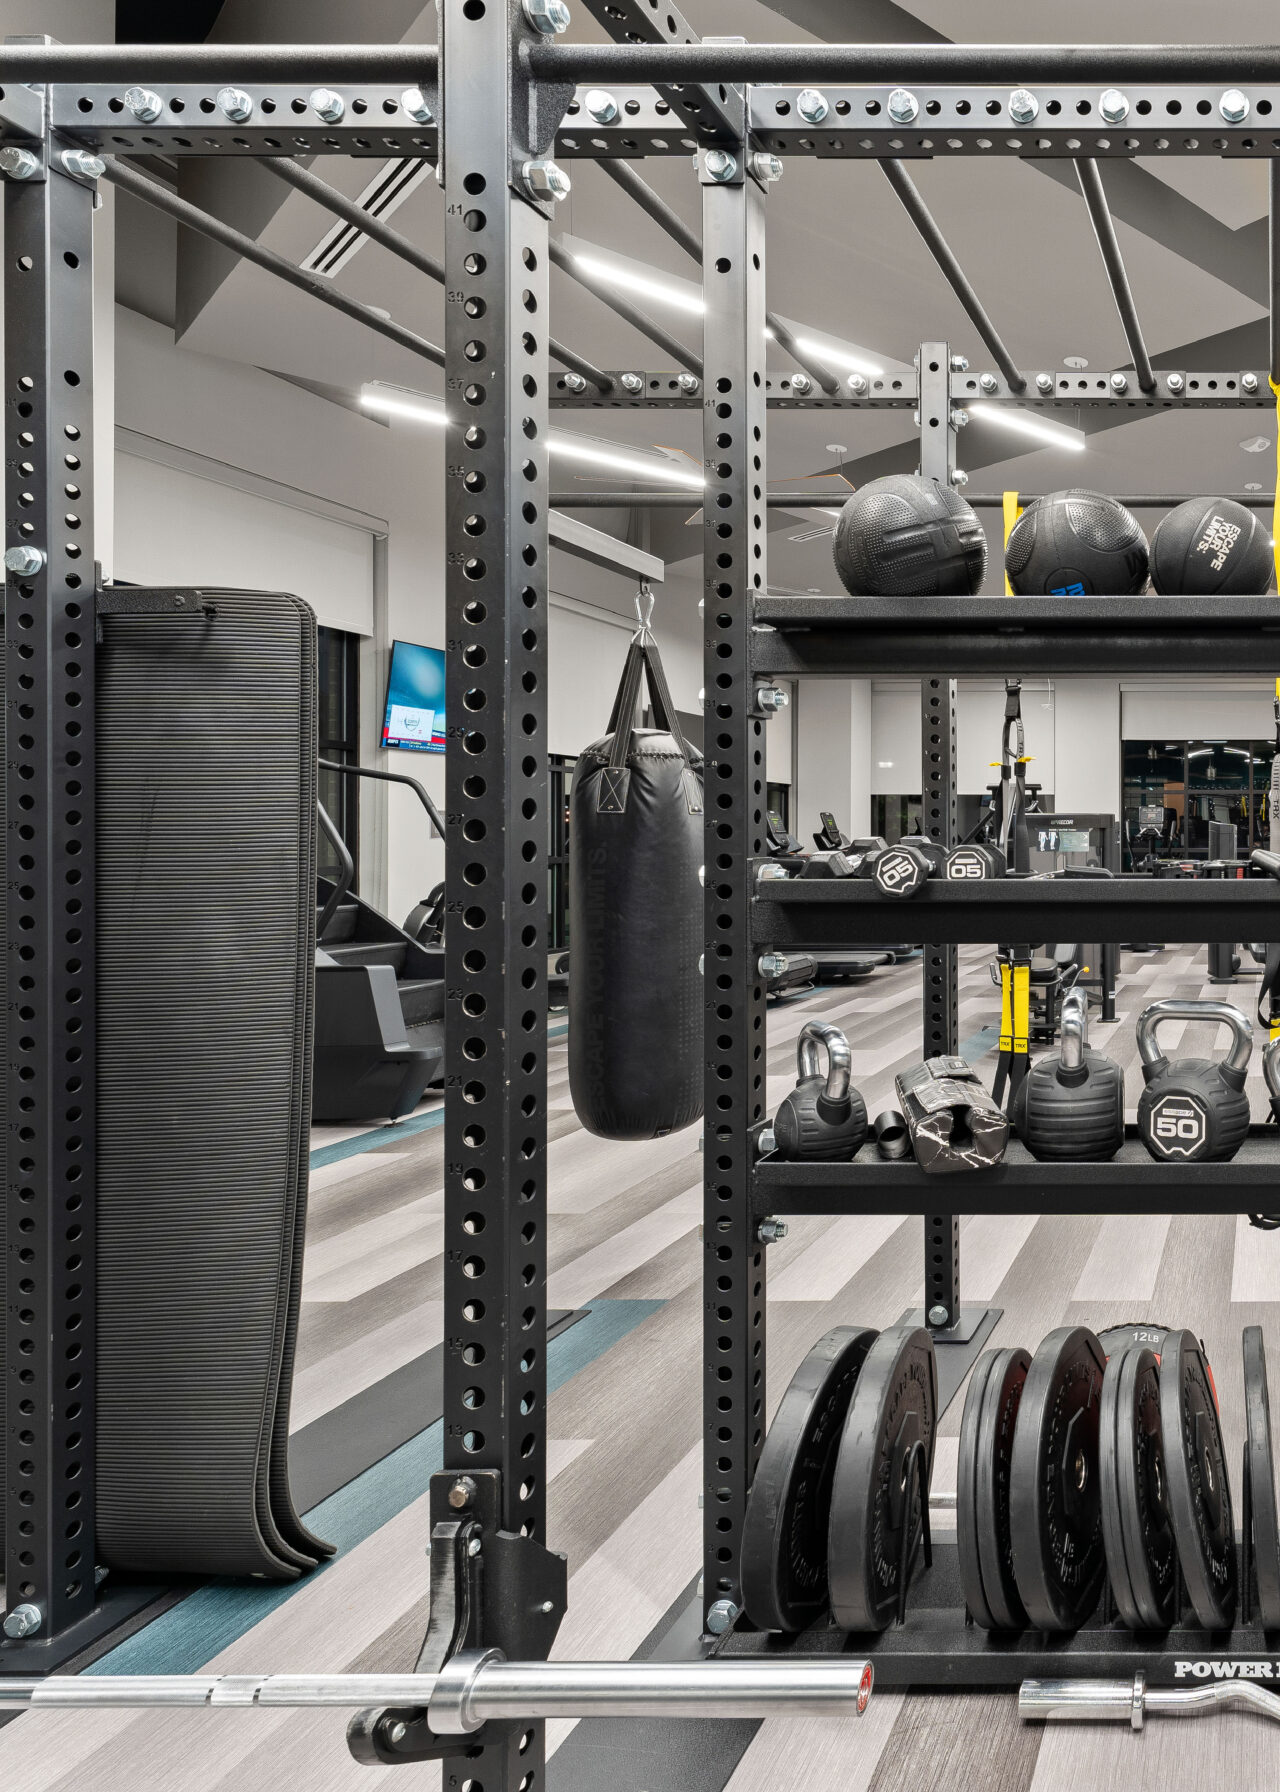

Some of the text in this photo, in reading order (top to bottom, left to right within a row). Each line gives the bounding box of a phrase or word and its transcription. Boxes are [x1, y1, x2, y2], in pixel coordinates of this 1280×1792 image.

[447, 203, 464, 217] 41
[447, 290, 464, 304] 39
[447, 377, 464, 391] 37
[447, 465, 464, 479] 35
[1210, 522, 1232, 551] YOUR
[1210, 525, 1241, 571] ESCAPE
[447, 552, 464, 566] 33
[447, 639, 464, 652] 31
[447, 726, 464, 740] 29
[447, 813, 464, 826] 27
[883, 860, 914, 886] 05
[951, 864, 981, 878] 05
[447, 901, 464, 914] 25
[585, 936, 604, 1004] YOUR
[447, 988, 464, 1001] 23
[447, 1075, 464, 1088] 21
[1156, 1117, 1199, 1139] 50
[447, 1162, 464, 1175] 19
[447, 1249, 464, 1262] 17
[447, 1337, 464, 1350] 15
[447, 1424, 464, 1437] 13
[448, 1774, 458, 1788] 5
